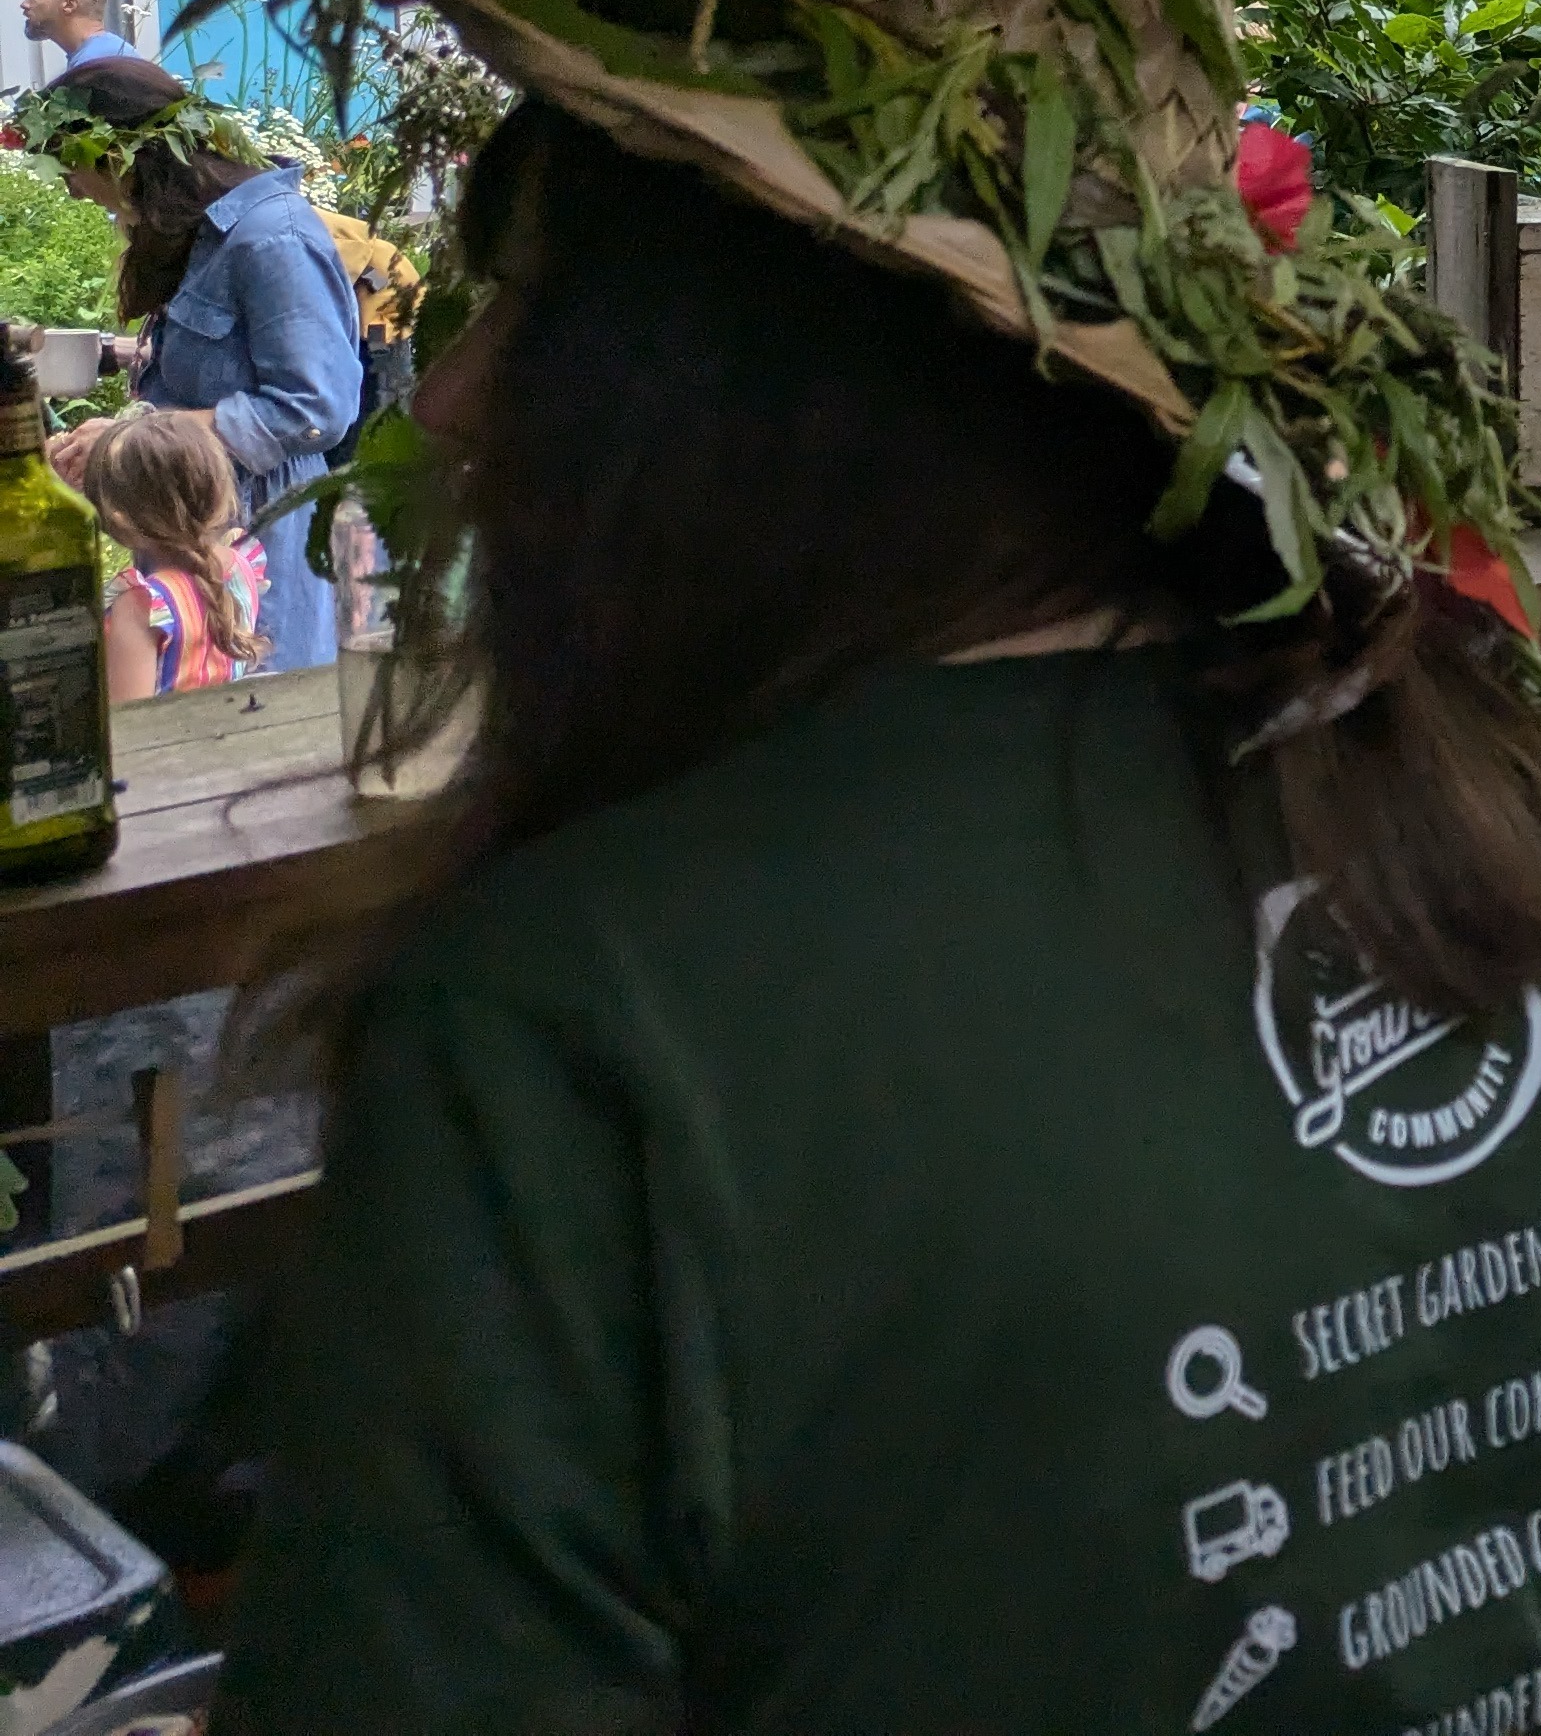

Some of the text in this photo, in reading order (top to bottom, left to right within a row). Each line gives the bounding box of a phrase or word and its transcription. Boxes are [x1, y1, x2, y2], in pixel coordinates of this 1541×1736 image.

[1367, 1041, 1512, 1150] COMMUNITY
[1292, 1274, 1405, 1381] SECRET
[1316, 1435, 1395, 1527] FEED
[1399, 1397, 1477, 1484] OUR
[1340, 1525, 1528, 1672] GROUNDED
